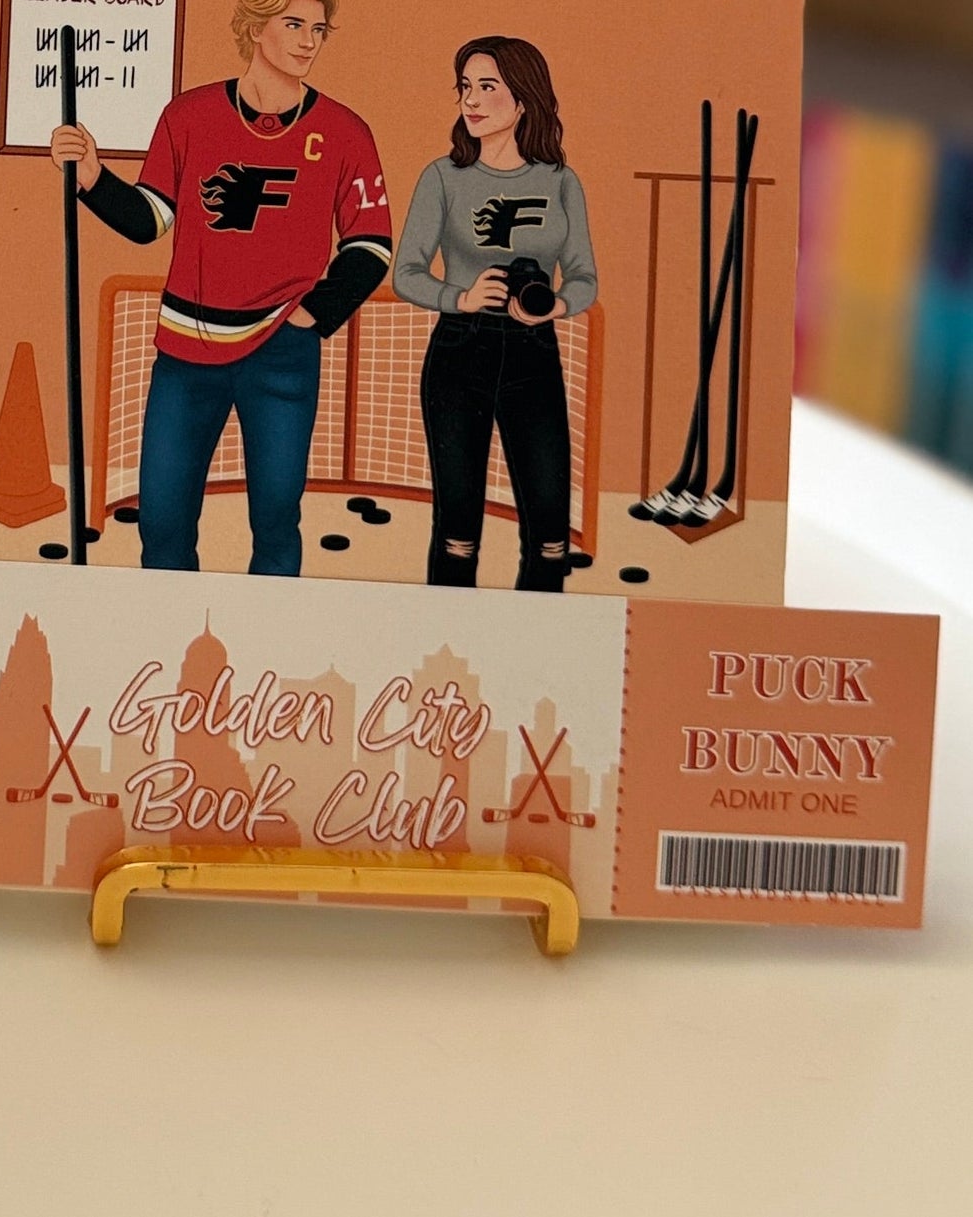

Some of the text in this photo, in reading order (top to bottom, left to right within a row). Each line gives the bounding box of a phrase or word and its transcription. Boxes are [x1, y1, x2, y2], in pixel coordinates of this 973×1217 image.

[304, 132, 323, 161] C
[708, 651, 871, 703] PUCK
[109, 661, 491, 760] Golden City
[680, 726, 893, 781] BUNNY
[126, 759, 467, 849] Book Club
[709, 787, 858, 815] ADMIT ONE
